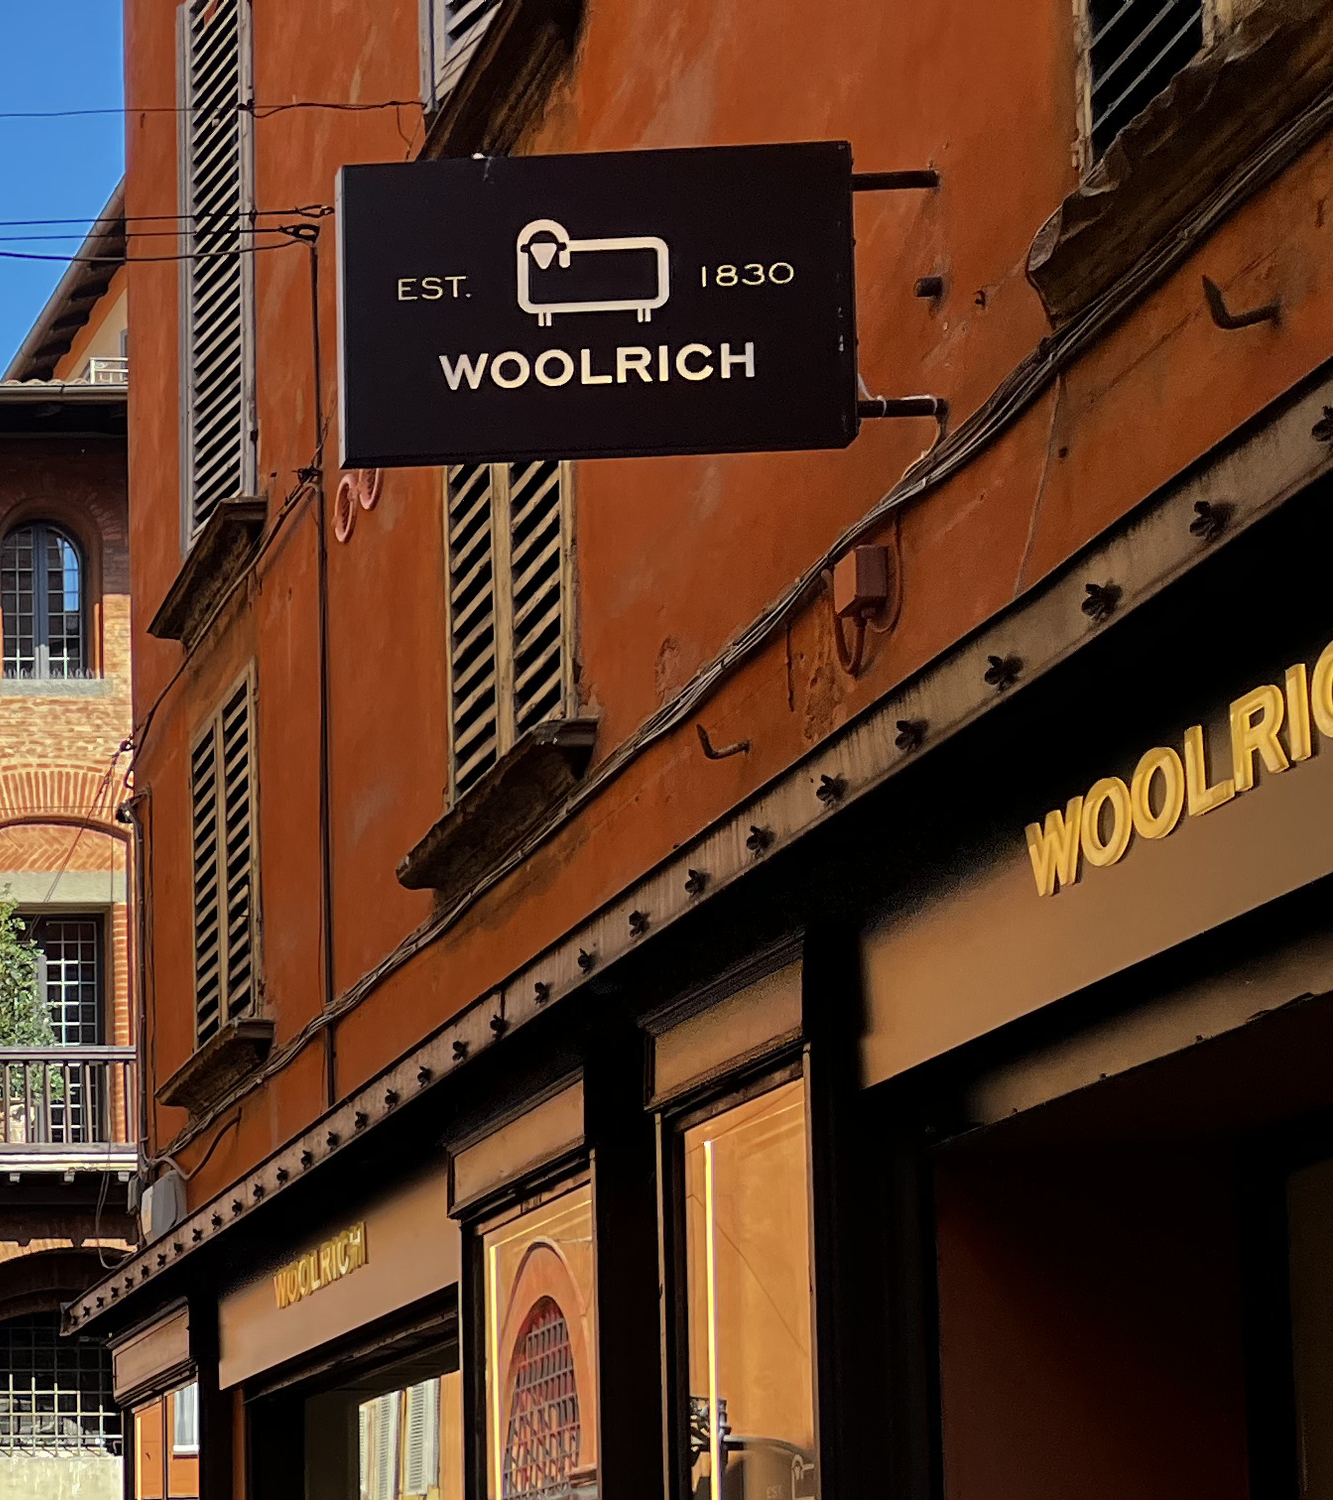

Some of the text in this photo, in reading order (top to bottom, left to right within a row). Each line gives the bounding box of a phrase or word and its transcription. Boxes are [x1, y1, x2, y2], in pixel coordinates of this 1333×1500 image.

[396, 261, 795, 302] EST. 1830
[438, 341, 757, 391] WOOLRICH
[273, 1220, 369, 1309] WOOLRICH
